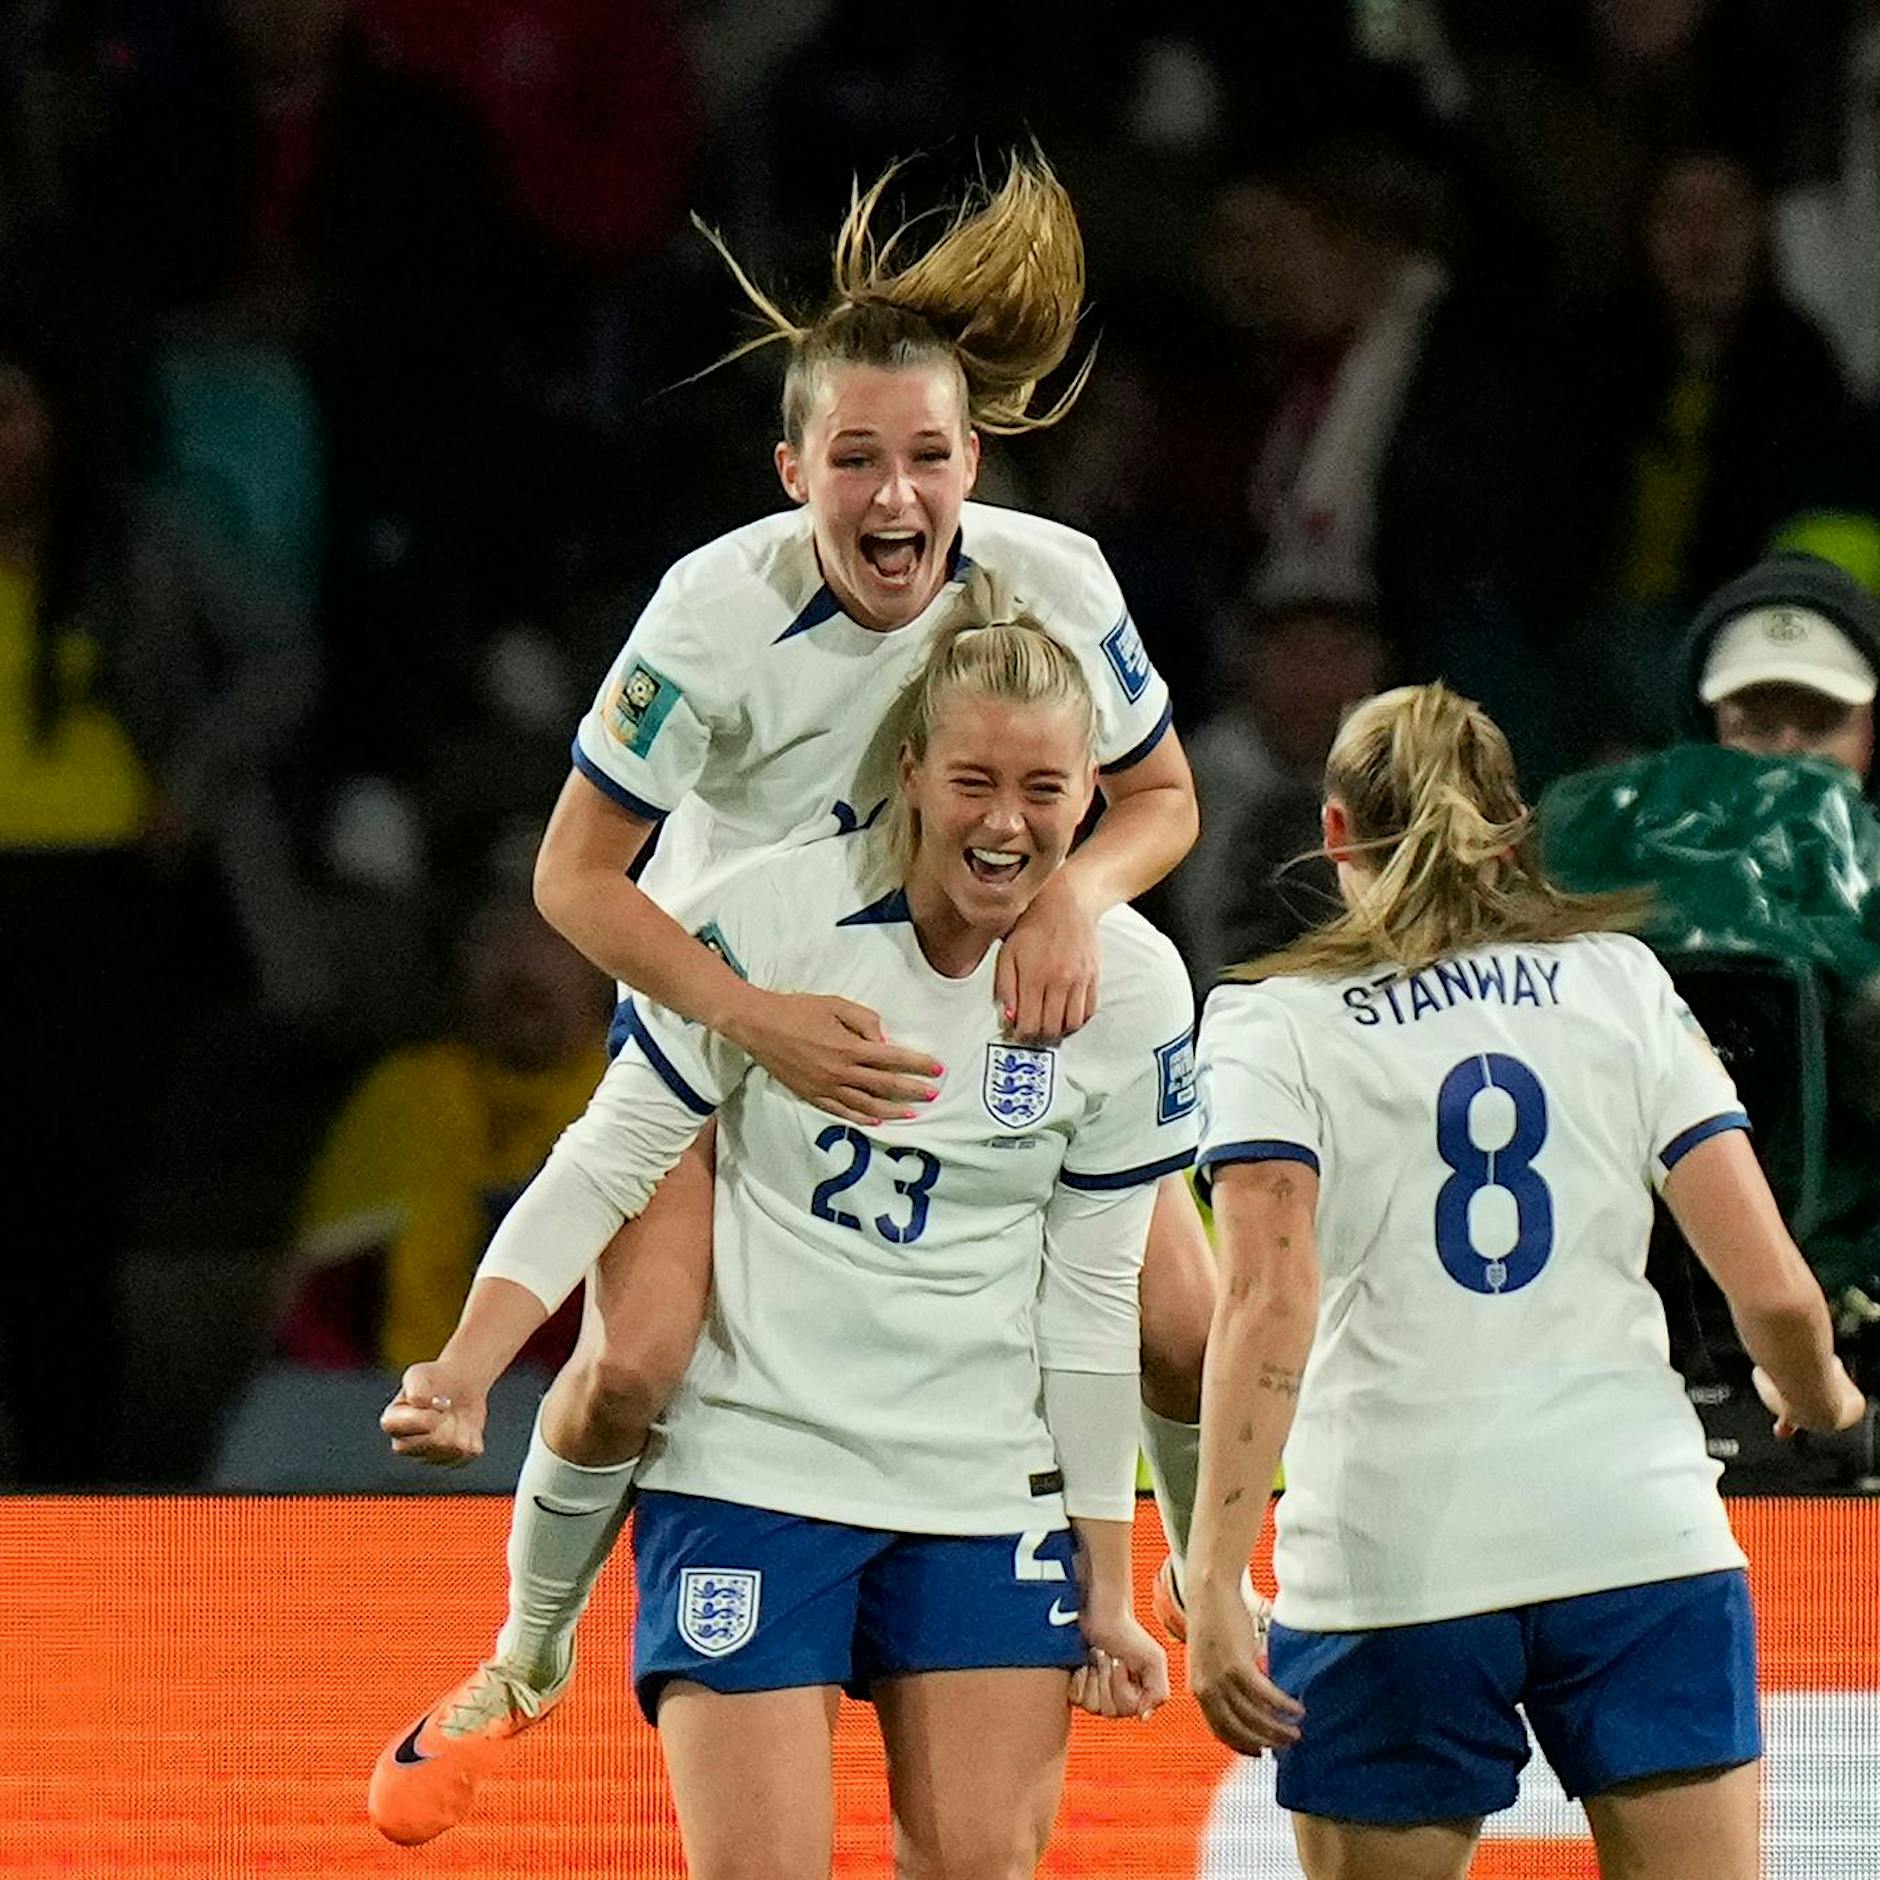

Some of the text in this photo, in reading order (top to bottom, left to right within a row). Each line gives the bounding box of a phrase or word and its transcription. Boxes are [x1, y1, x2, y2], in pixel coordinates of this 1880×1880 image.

[1342, 955, 1560, 1026] STANWAY
[811, 1124, 941, 1245] 23
[1434, 1052, 1554, 1294] 8
